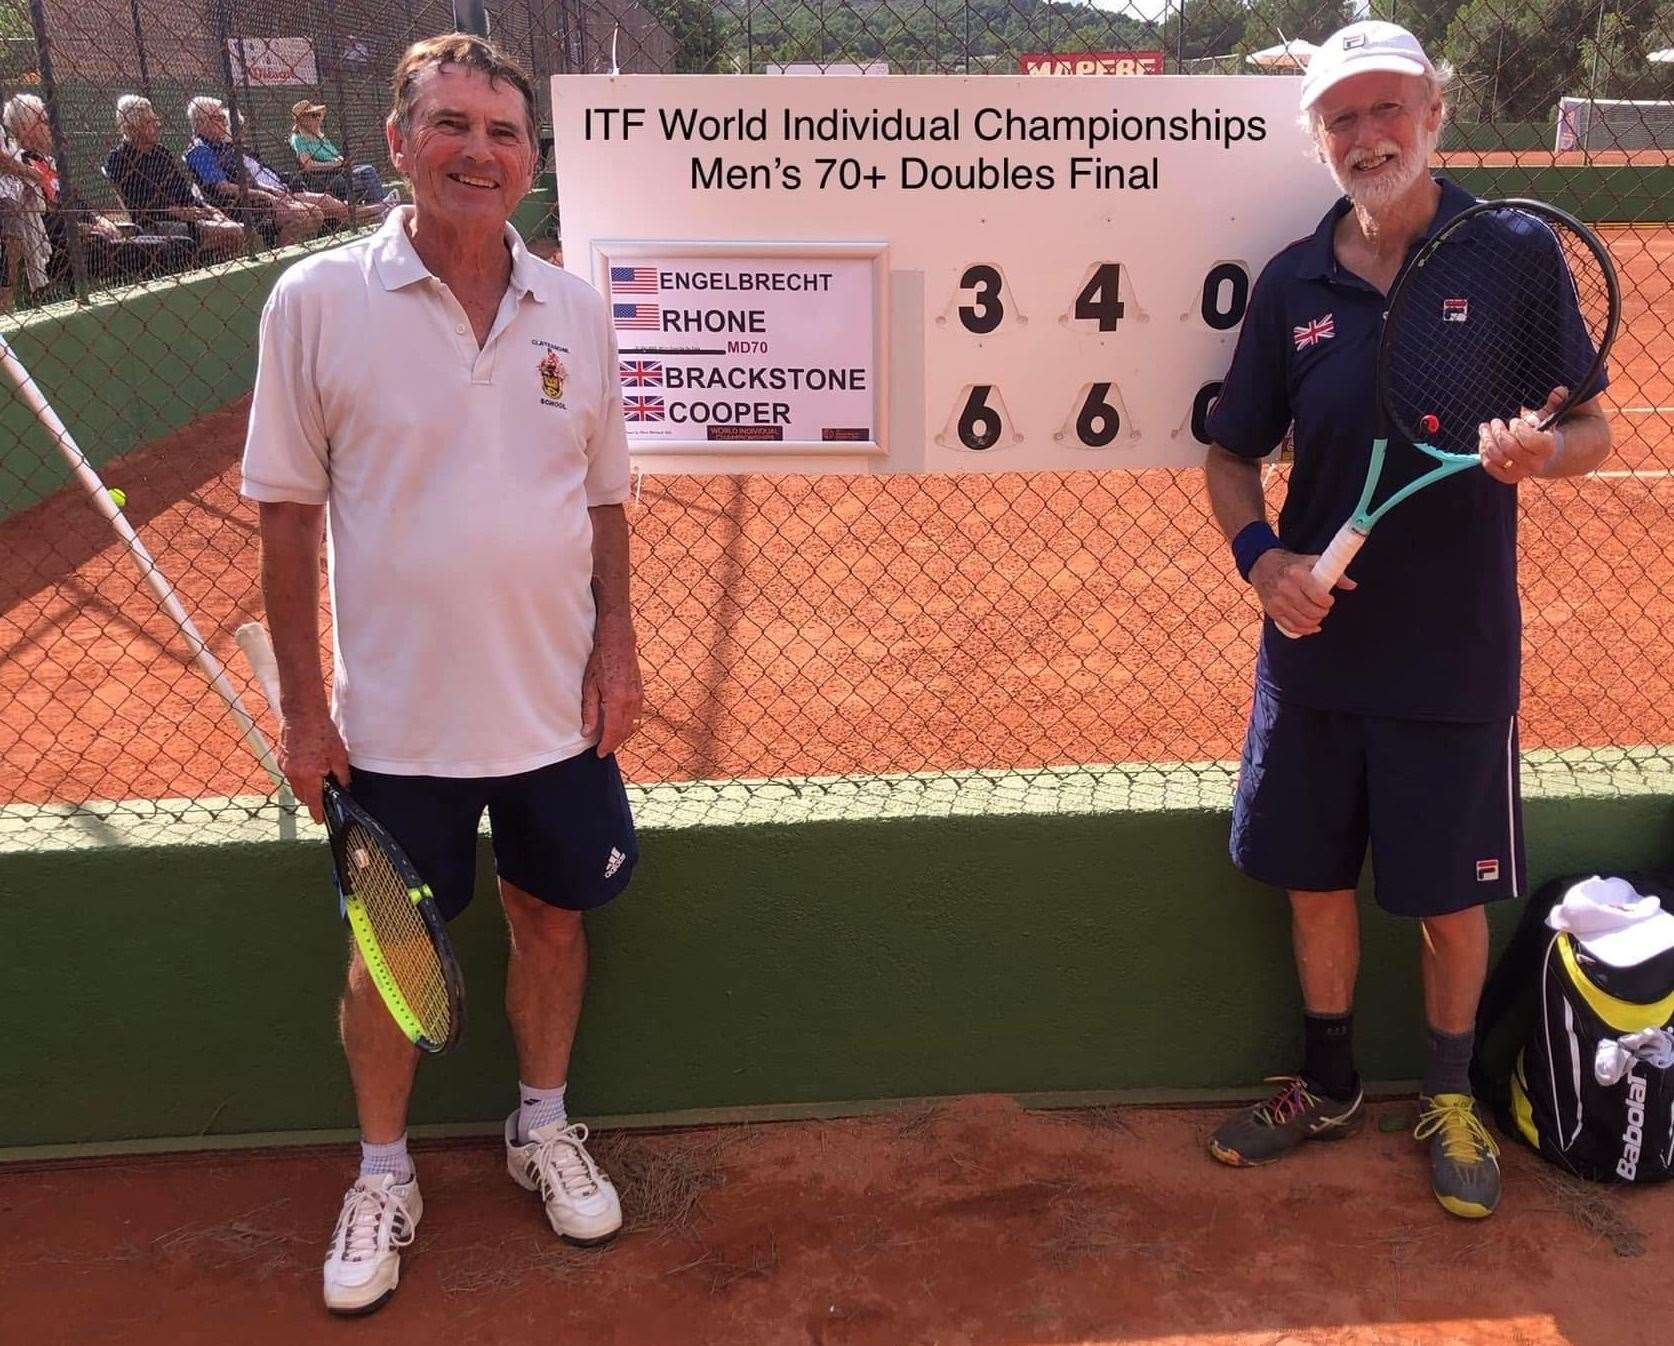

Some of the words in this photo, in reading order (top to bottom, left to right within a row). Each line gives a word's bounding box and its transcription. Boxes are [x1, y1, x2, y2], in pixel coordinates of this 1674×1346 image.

[659, 272, 833, 292] ENGELBRECHT
[958, 264, 1004, 334] 3
[1075, 264, 1125, 332] 4
[1201, 263, 1249, 330] 0
[662, 309, 766, 333] RHONE
[727, 340, 768, 355] MD70
[665, 367, 866, 391] BRACKSTONE
[669, 402, 793, 425] COOPER
[957, 385, 1002, 451] 6
[1075, 382, 1120, 447] 6
[1615, 1069, 1648, 1182] Babolat
